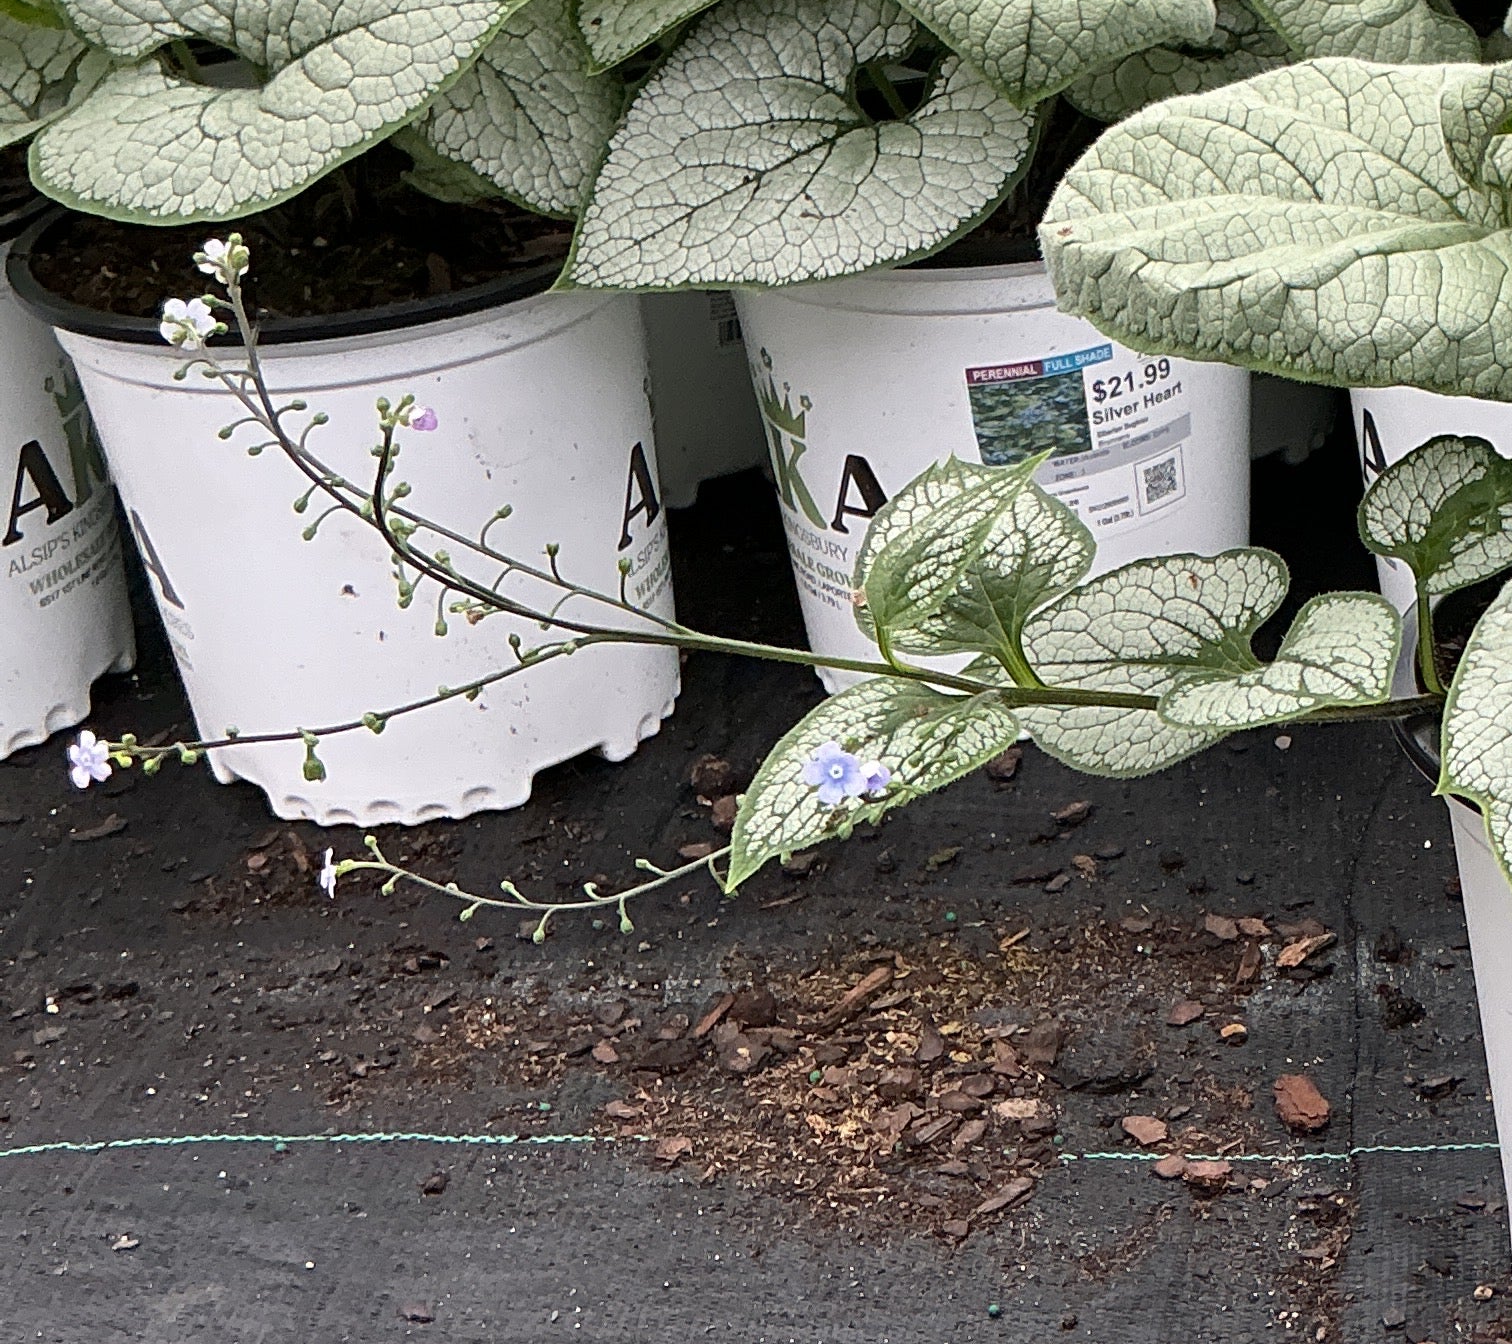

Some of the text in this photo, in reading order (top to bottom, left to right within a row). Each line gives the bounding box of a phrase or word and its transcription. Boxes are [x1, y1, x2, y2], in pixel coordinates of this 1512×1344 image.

[973, 346, 1111, 382] PERENNIAL FULL SHADE
[1092, 357, 1171, 406] $21.99
[1092, 380, 1183, 426] Silver Heart
